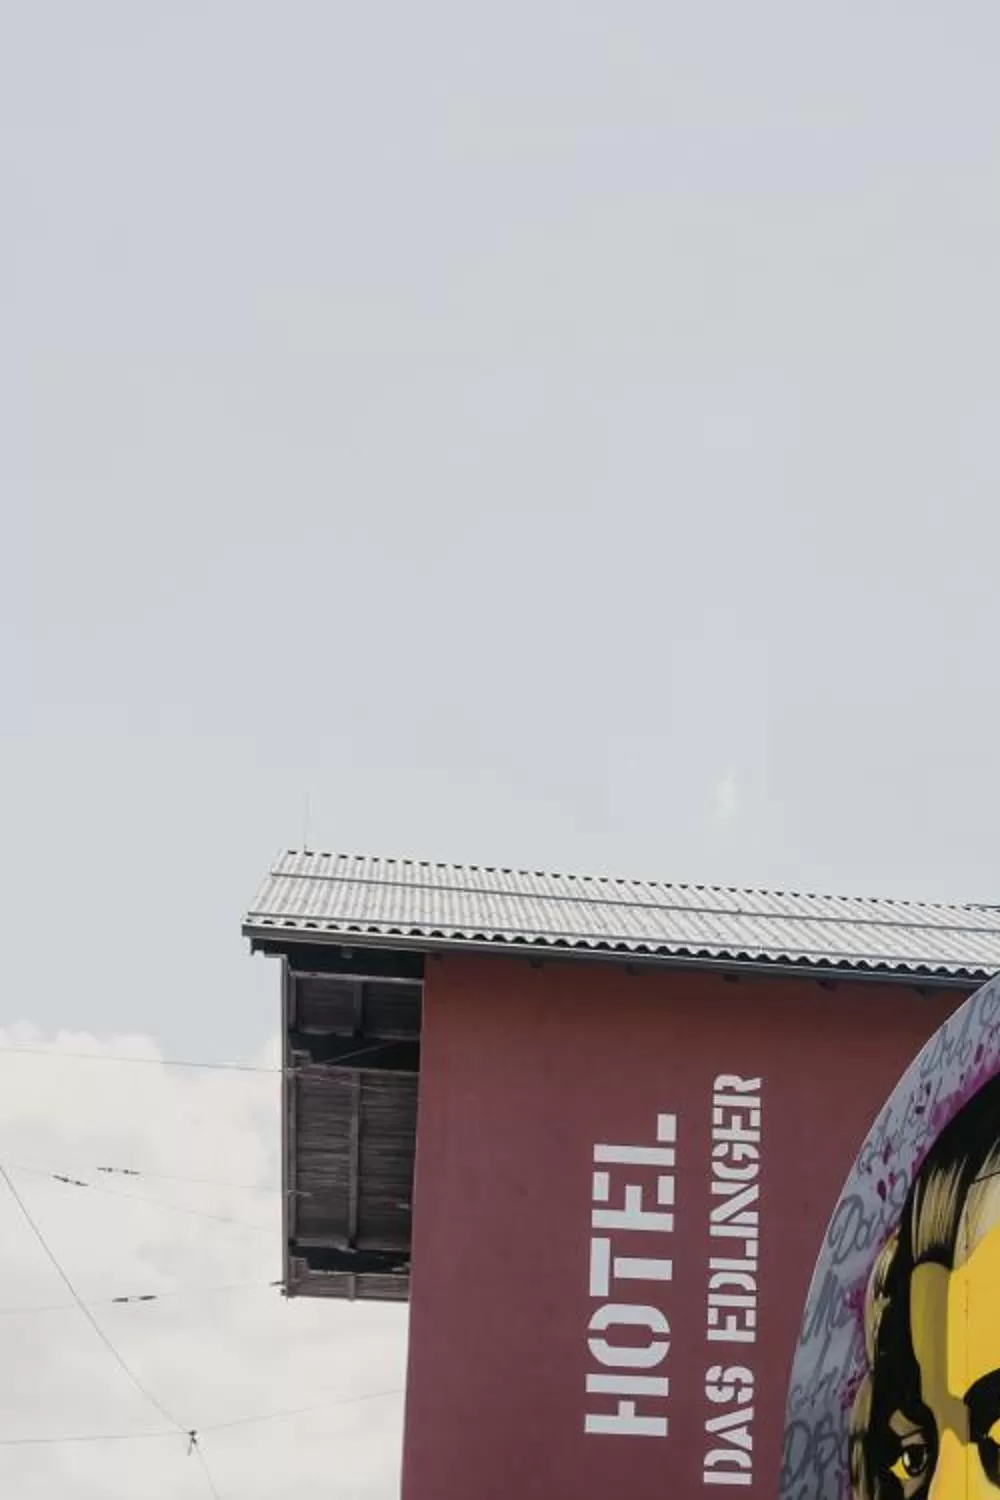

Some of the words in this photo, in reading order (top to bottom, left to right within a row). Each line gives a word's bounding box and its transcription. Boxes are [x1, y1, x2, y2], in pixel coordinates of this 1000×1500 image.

[584, 1112, 678, 1437] HOTEL
[706, 1073, 762, 1343] EDLINGER
[703, 1365, 755, 1485] DAS
